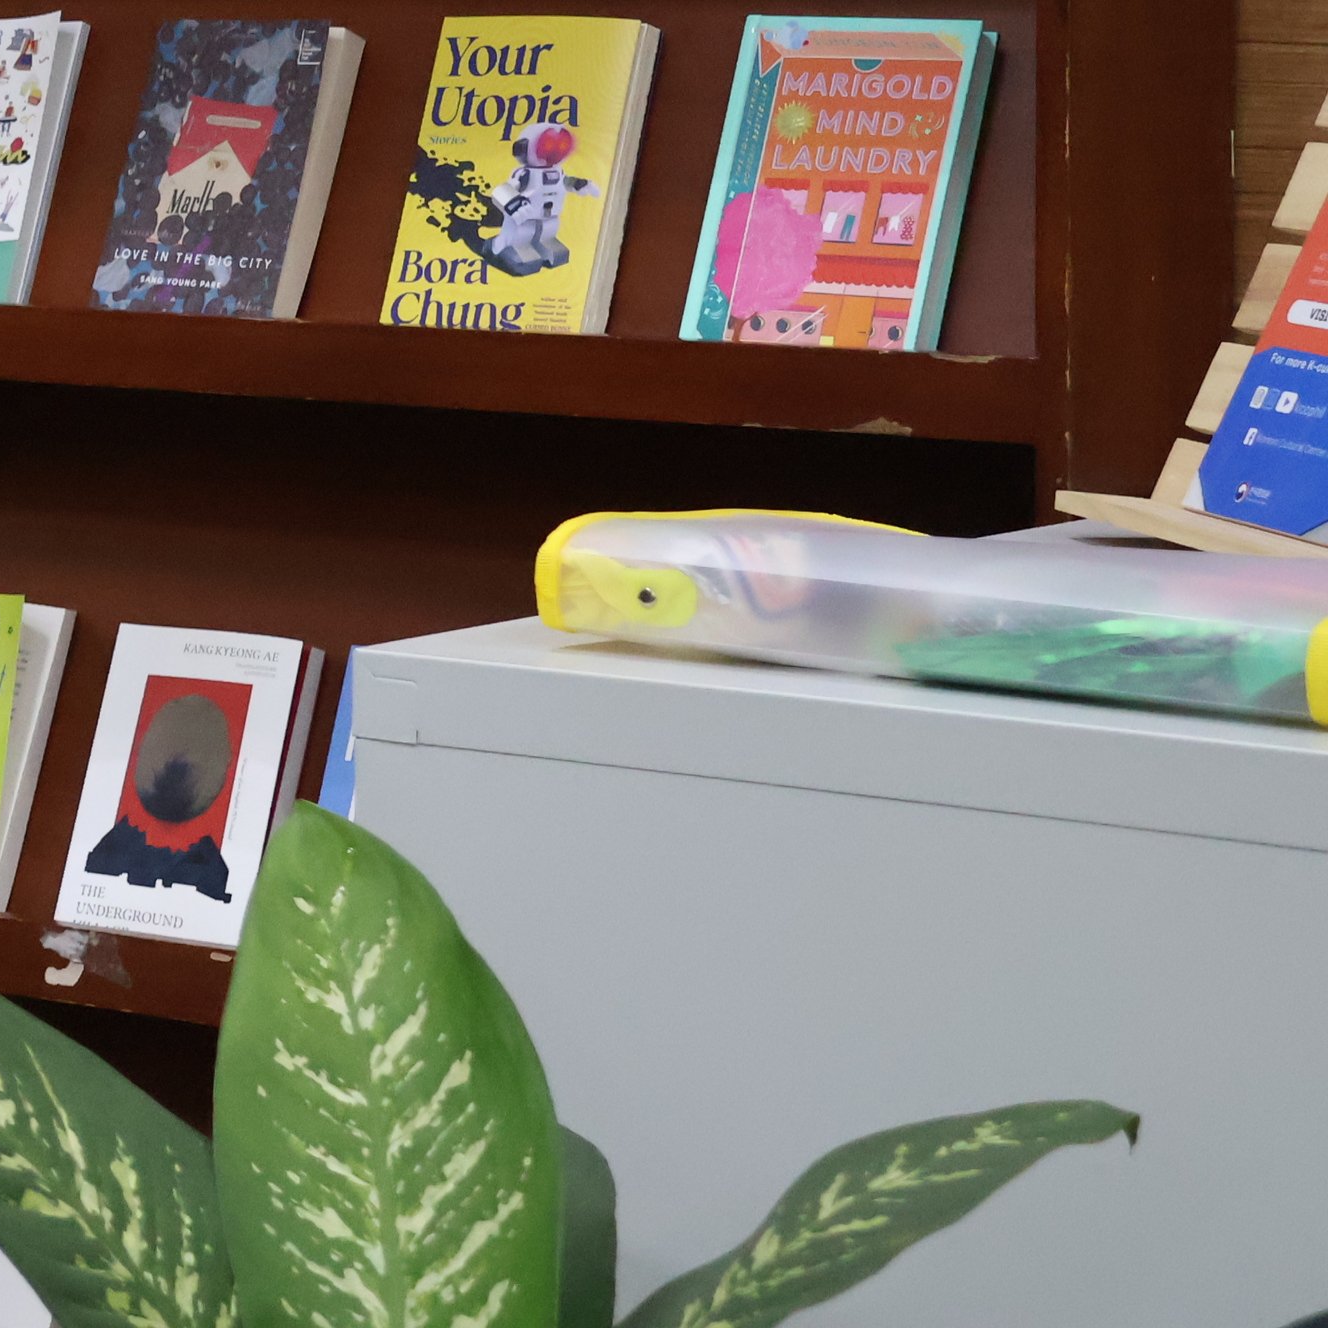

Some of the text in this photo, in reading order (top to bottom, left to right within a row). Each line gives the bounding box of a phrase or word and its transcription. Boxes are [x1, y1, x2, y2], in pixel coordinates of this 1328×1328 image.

[446, 36, 554, 77] Your
[780, 71, 953, 101] MARIGOLD
[431, 84, 579, 142] Utopia
[816, 110, 905, 137] MIND
[428, 134, 468, 146] Stories
[771, 144, 937, 175] LAUNDRY
[113, 247, 274, 270] LOVE IN THE BIG CITY
[397, 249, 490, 285] Bora
[389, 288, 526, 331] Chung
[183, 642, 214, 656] KANG
[263, 650, 280, 663] AE
[80, 883, 106, 899] THE
[75, 900, 184, 930] UNDERGROUND
